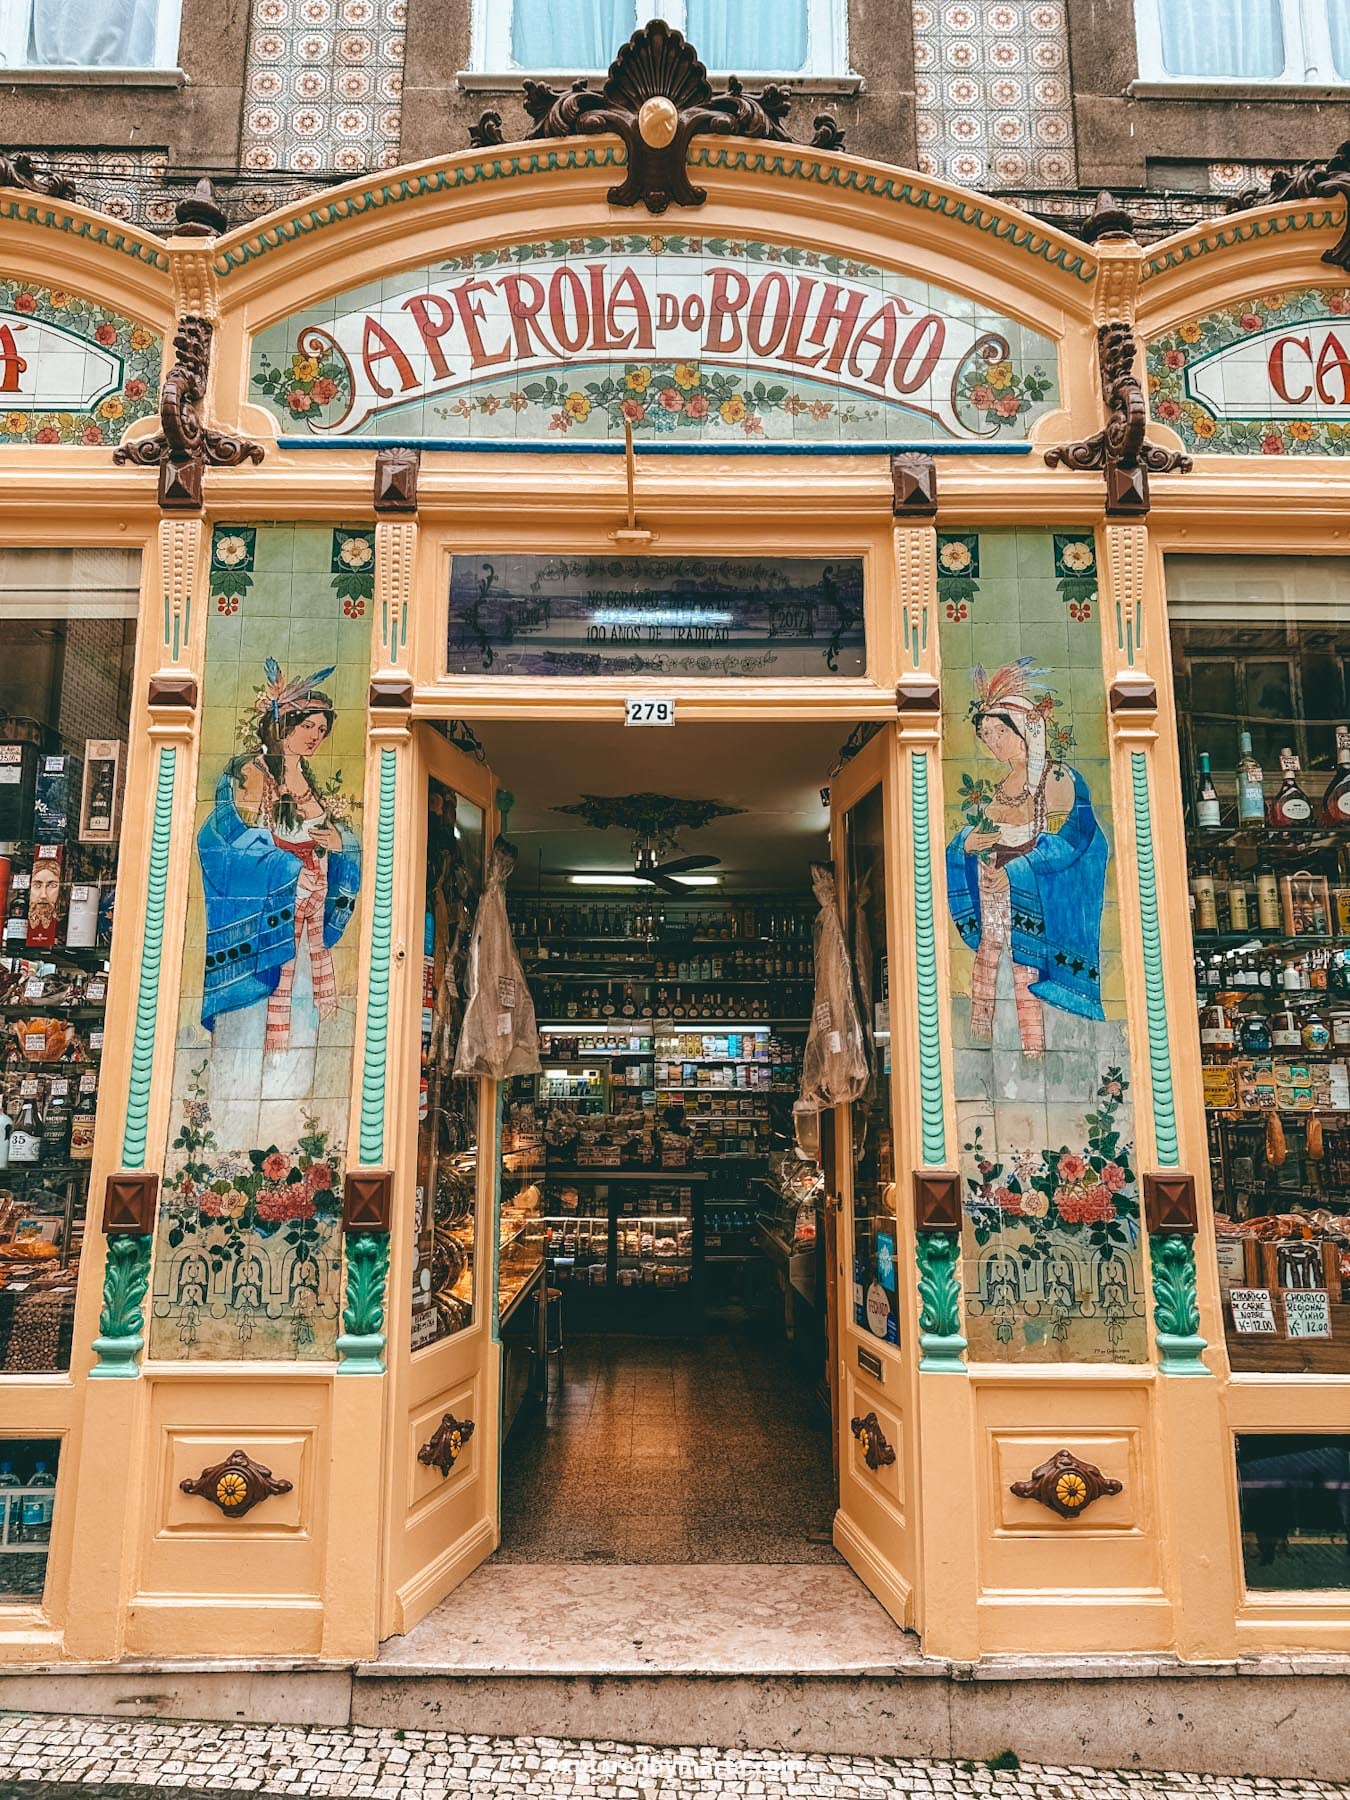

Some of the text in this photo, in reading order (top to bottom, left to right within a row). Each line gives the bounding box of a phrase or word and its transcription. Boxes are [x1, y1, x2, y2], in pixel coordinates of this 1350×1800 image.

[362, 263, 947, 399] A PÉROLA DO BOLHÃO
[587, 622, 730, 648] 100 ANOS DE TRADIÇÃO
[631, 703, 668, 721] 279
[12, 1135, 26, 1145] 35
